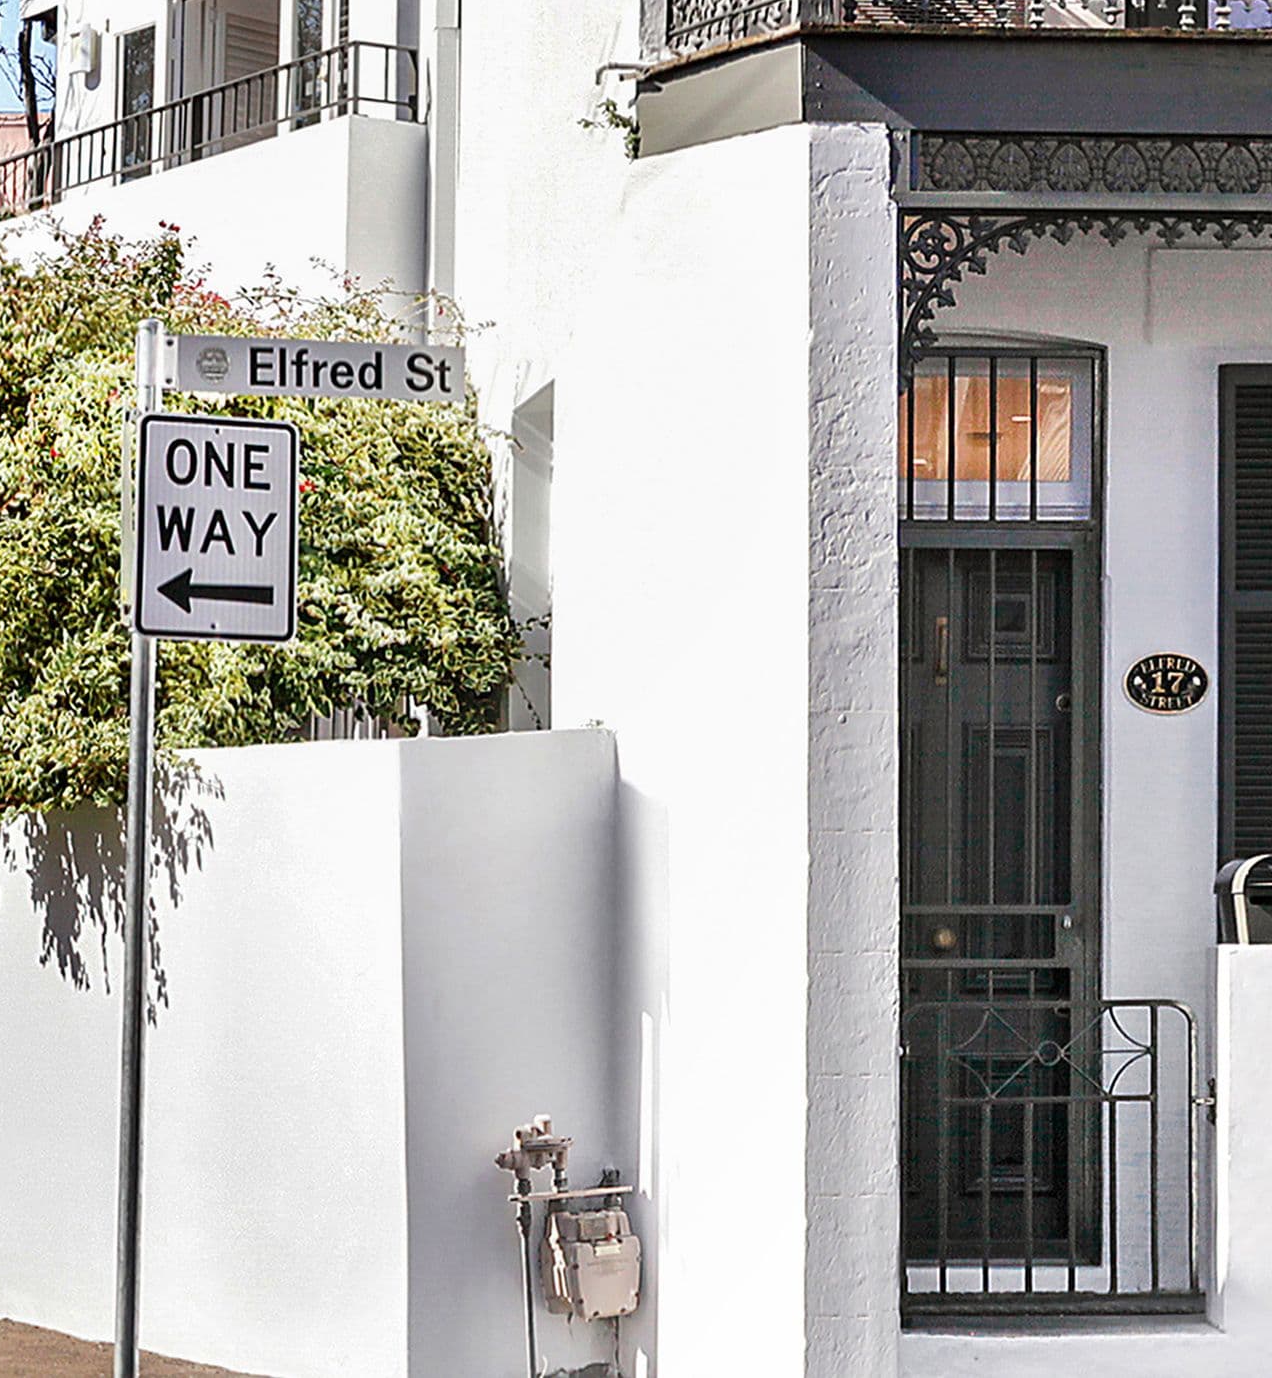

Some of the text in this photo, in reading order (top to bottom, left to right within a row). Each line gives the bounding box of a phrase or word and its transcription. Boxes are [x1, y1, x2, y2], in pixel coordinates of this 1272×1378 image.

[249, 347, 452, 392] Elfred St
[166, 438, 271, 490] ONE
[156, 505, 277, 557] WAY
[1140, 657, 1197, 674] ELFRED
[1151, 671, 1185, 693] 17
[1140, 693, 1193, 709] STREET
